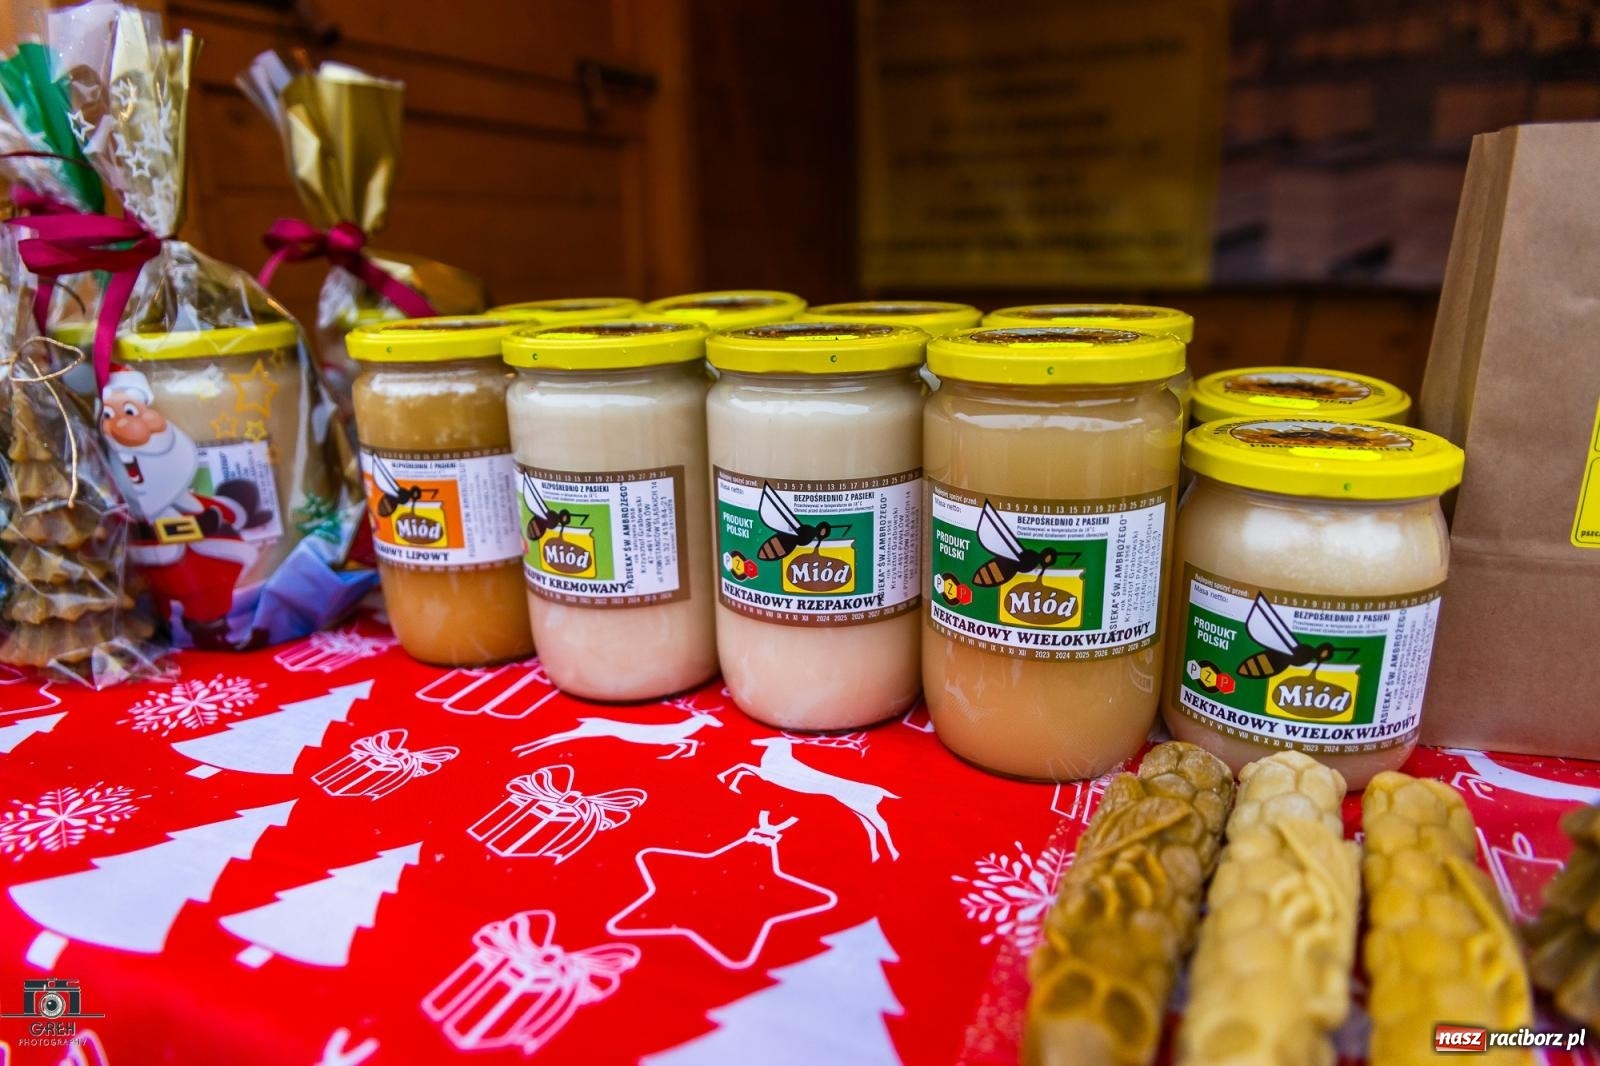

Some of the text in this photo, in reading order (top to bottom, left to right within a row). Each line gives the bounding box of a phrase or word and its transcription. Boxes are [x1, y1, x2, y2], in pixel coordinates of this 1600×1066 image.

[585, 485, 609, 493] PASIEKI
[776, 482, 780, 490] 1
[807, 483, 812, 491] 9
[816, 483, 823, 491] 11
[827, 483, 835, 491] 13
[850, 482, 858, 490] 17
[861, 481, 869, 489] 19
[793, 492, 843, 502] BEZPOŚREDNIO
[850, 491, 875, 501] PASIEKI
[999, 502, 1002, 510] 1
[1006, 502, 1011, 510] 3
[1024, 504, 1029, 512] 7
[1033, 504, 1038, 513] 9
[1043, 505, 1050, 513] 11
[1056, 505, 1065, 514] 13
[1082, 505, 1091, 513] 17
[1095, 505, 1104, 513] 19
[396, 516, 441, 539] Miód
[722, 511, 755, 530] PRODUKT
[1017, 515, 1110, 526] BEZPOŚREDNIO Z PASIEKI
[726, 524, 751, 539] POLSKI
[936, 528, 971, 552] PRODUKT
[544, 543, 590, 569] Miód
[939, 543, 965, 562] POLSKI
[790, 560, 850, 585] Miód
[1124, 530, 1139, 623] Krzysztof Grabowski
[549, 578, 628, 594] KREMOWANY
[1193, 584, 1229, 603] Masa netto:
[723, 581, 793, 609] NEKTAROWY
[797, 594, 884, 611] RZEPAKOWY
[1008, 591, 1078, 618] Miód
[1292, 598, 1298, 606] 5
[1303, 599, 1308, 607] 7
[1312, 600, 1318, 608] 9
[1322, 601, 1331, 609] 11
[1336, 601, 1346, 610] 13
[1351, 602, 1360, 610] 15
[1364, 602, 1373, 610] 17
[816, 614, 830, 623] 2024
[834, 614, 848, 622] 2025
[851, 612, 865, 621] 2026
[1293, 610, 1391, 623] BEZPOŚREDNIO Z PASIEKI
[933, 606, 1152, 648] NEKTAROWY WIELOKWIATOWY
[1193, 615, 1238, 642] PRODUKT
[1197, 629, 1230, 652] POLSKI
[1018, 649, 1027, 657] XII
[1035, 650, 1051, 659] 2023
[1055, 651, 1070, 659] 2024
[1075, 650, 1090, 659] 2025
[1094, 649, 1108, 658] 2026
[1111, 646, 1125, 656] 2027
[1277, 684, 1351, 713] Miód
[1183, 690, 1417, 741] NEKTAROWY WIELOKWIATOWY
[1263, 737, 1269, 745] X
[1302, 743, 1319, 752] 2023
[1323, 744, 1339, 753] 2024
[1344, 745, 1360, 753] 2025
